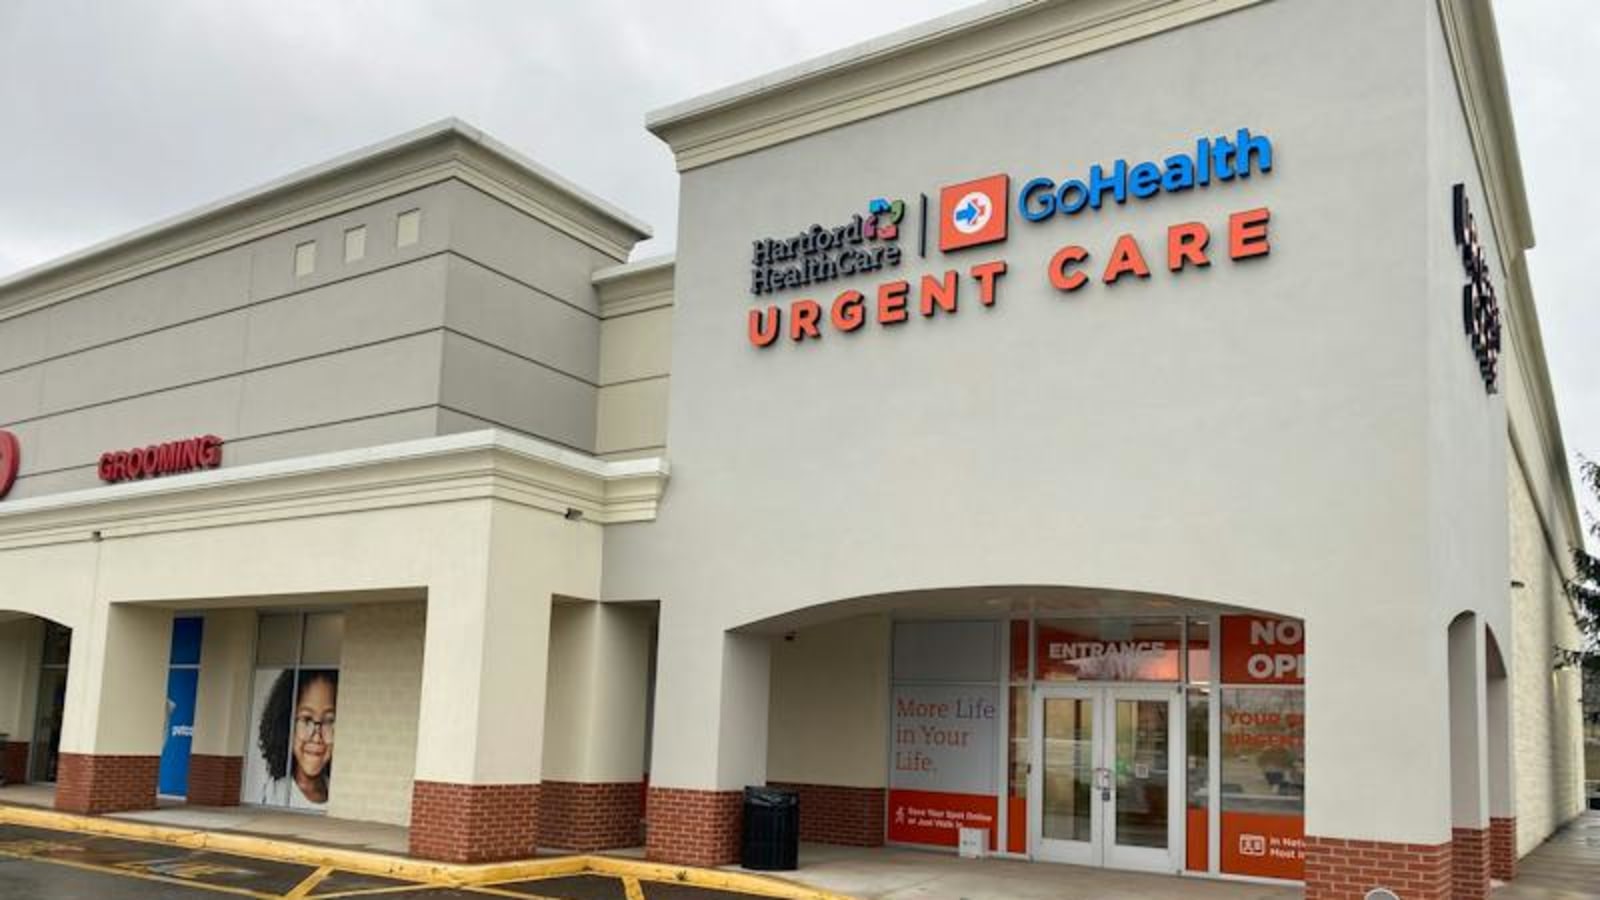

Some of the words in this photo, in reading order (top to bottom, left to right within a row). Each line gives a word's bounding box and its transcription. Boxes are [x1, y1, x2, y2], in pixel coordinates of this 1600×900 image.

[1018, 128, 1272, 222] GoHealth
[752, 213, 863, 266] Hartford
[749, 261, 1007, 347] URGENT
[1048, 207, 1271, 292] CARE
[750, 244, 901, 295] HealthCare
[98, 434, 223, 483] GROOMING
[1049, 641, 1166, 660] ENTRANCE
[896, 698, 949, 719] More
[956, 698, 995, 720] Life
[896, 725, 915, 746] in
[919, 724, 970, 748] Your
